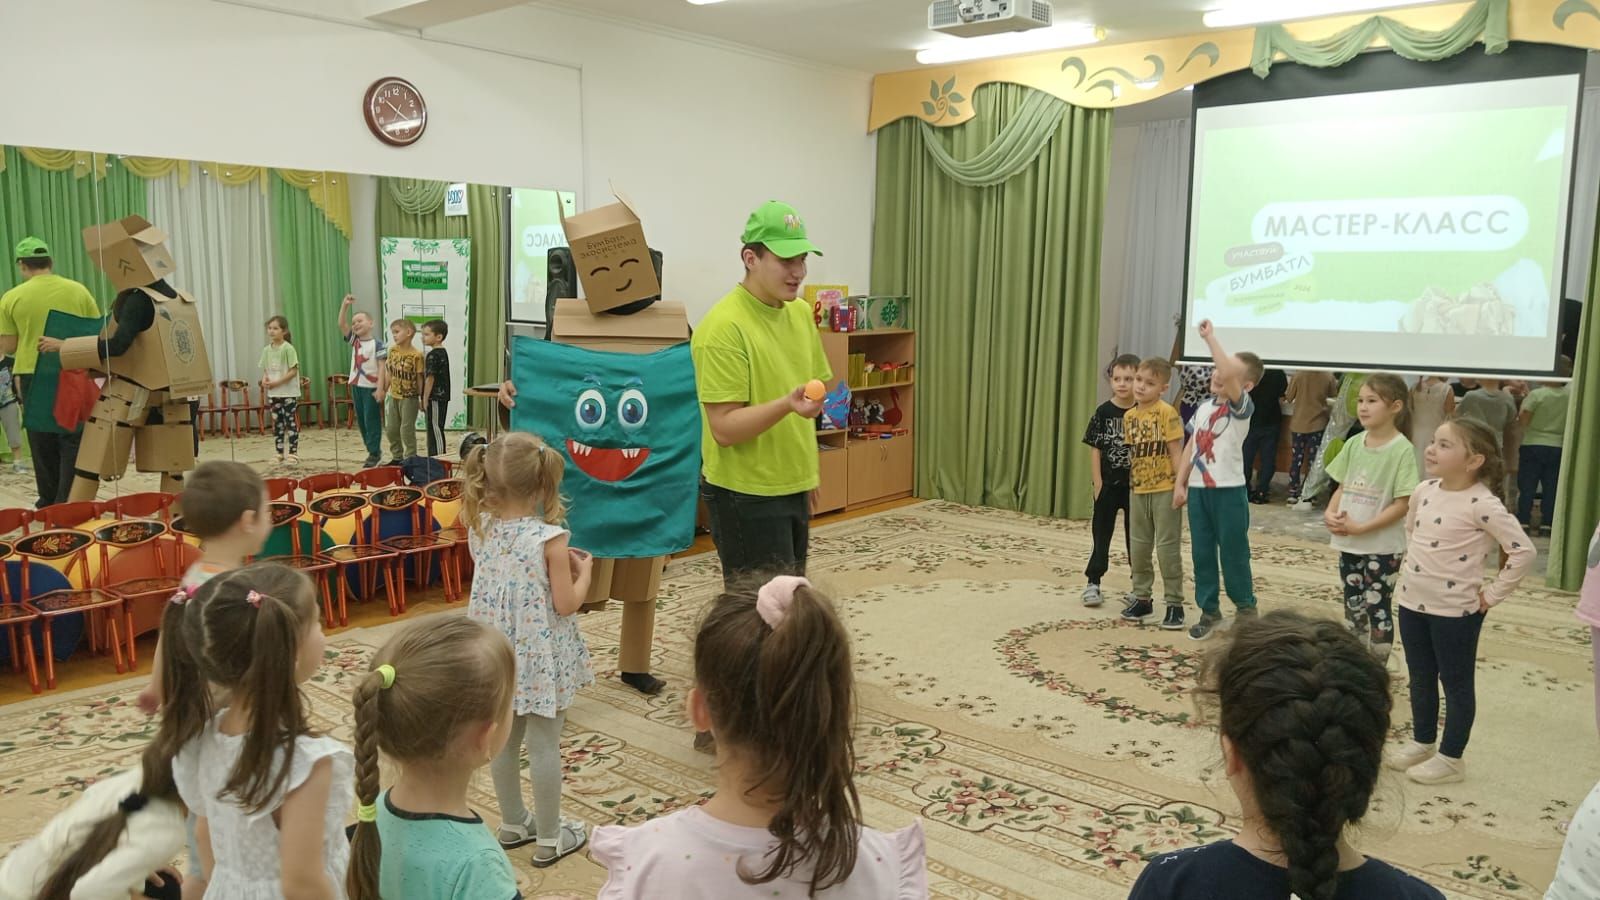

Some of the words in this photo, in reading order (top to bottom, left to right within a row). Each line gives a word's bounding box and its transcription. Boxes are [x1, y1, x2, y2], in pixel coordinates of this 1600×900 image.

[393, 87, 399, 95] 12
[1264, 210, 1510, 237] МАСТЕР-КЛАСС
[1230, 255, 1311, 292] БУМБАТЛ
